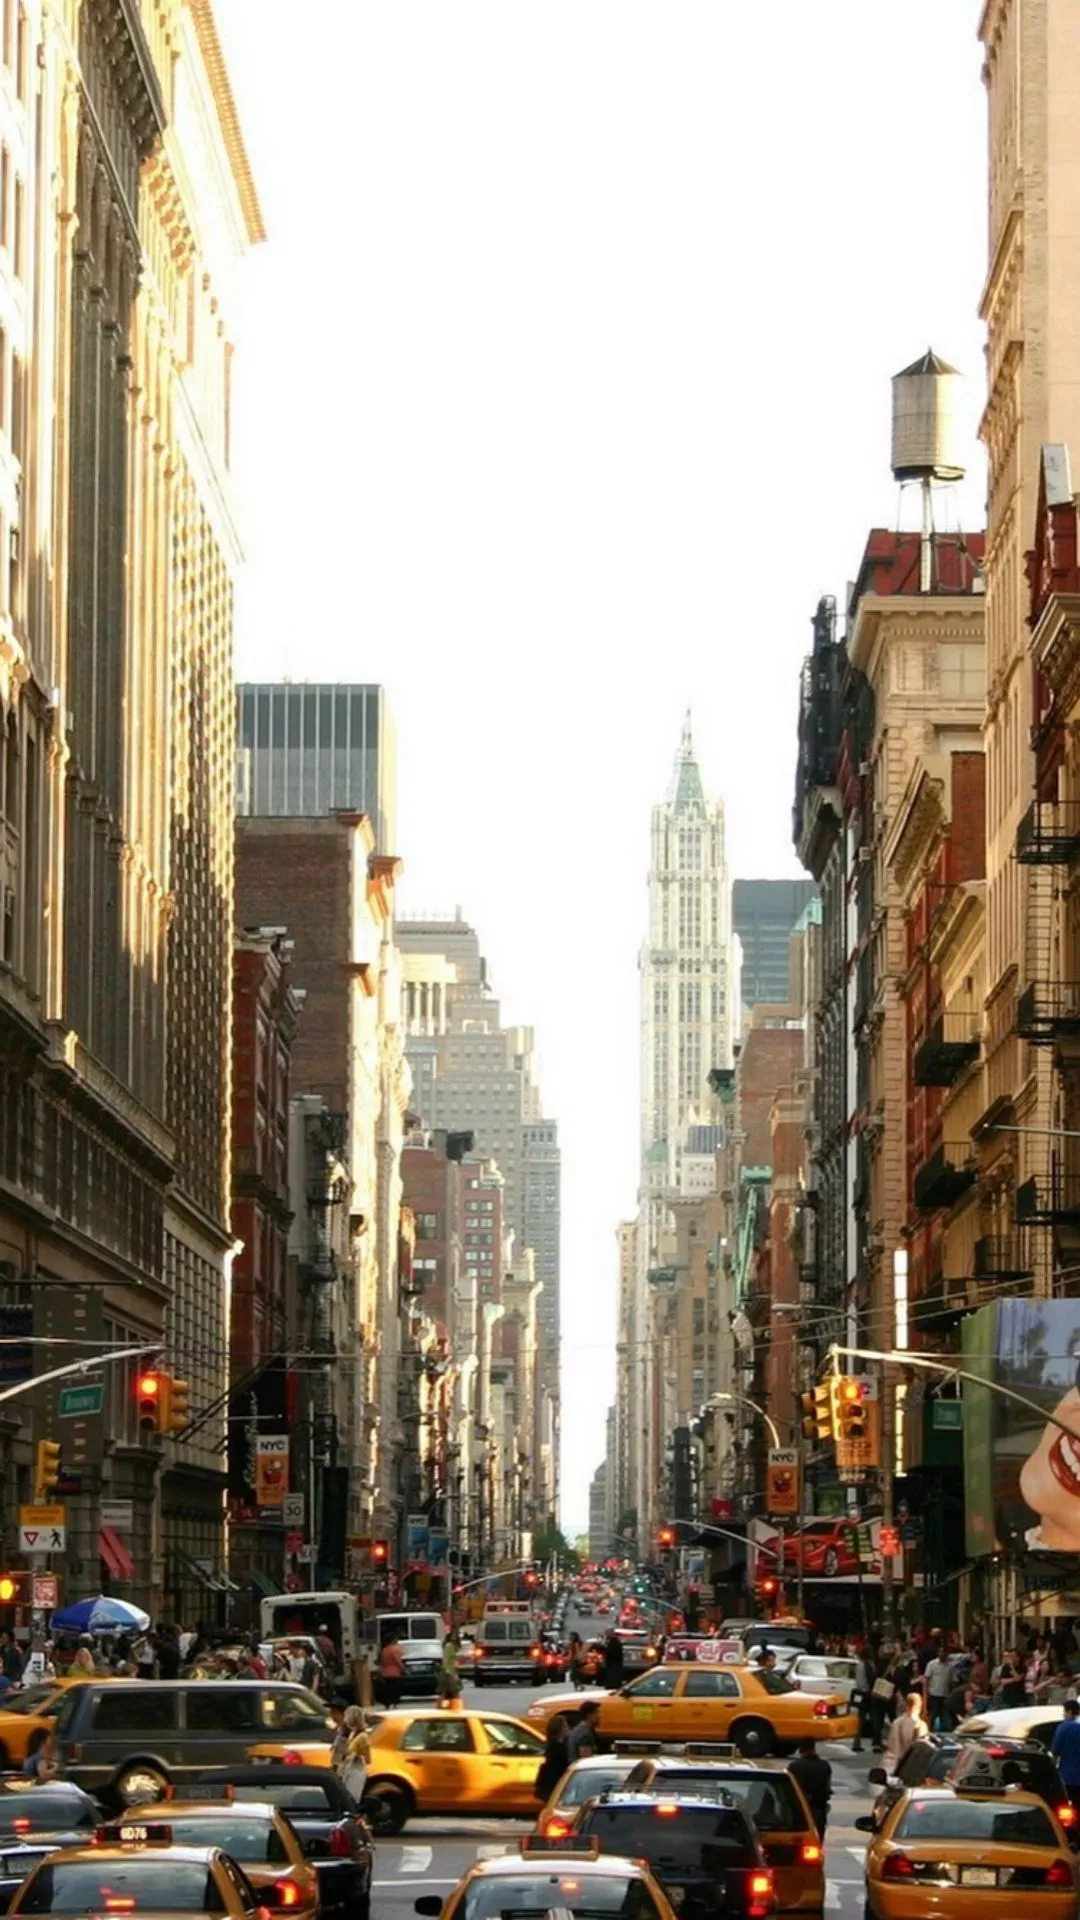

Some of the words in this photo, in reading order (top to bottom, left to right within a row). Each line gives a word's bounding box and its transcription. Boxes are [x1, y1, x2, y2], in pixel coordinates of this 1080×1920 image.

[260, 1441, 285, 1450] NYC
[771, 1453, 794, 1463] NYC
[285, 1505, 302, 1517] 30
